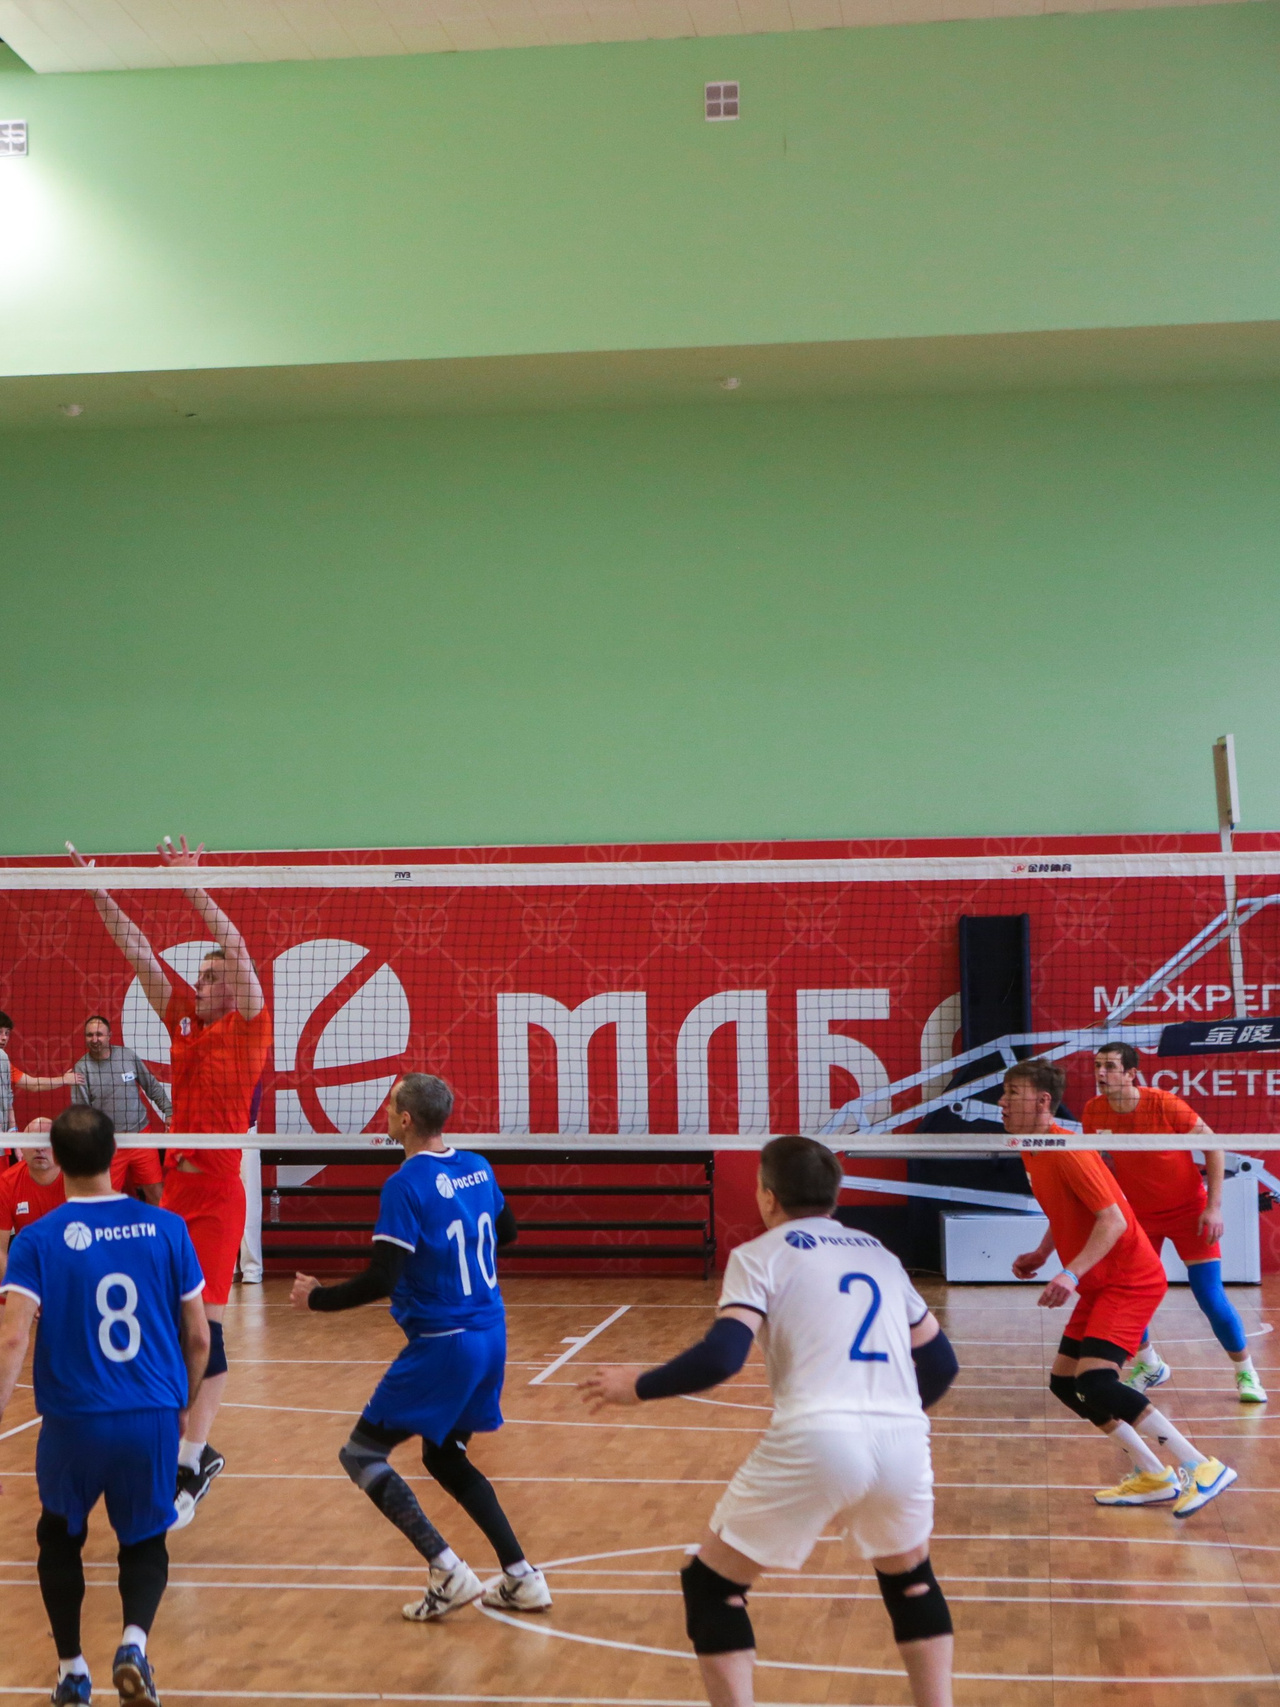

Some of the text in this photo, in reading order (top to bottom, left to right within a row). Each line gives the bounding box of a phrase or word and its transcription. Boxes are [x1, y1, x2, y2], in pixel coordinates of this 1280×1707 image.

[452, 1169, 489, 1191] РОССЕТИ
[94, 1222, 157, 1243] РОССЕТИ
[445, 1211, 498, 1297] 10
[818, 1234, 882, 1249] РОССЕТИ
[95, 1272, 142, 1363] 8
[838, 1271, 889, 1363] 2
